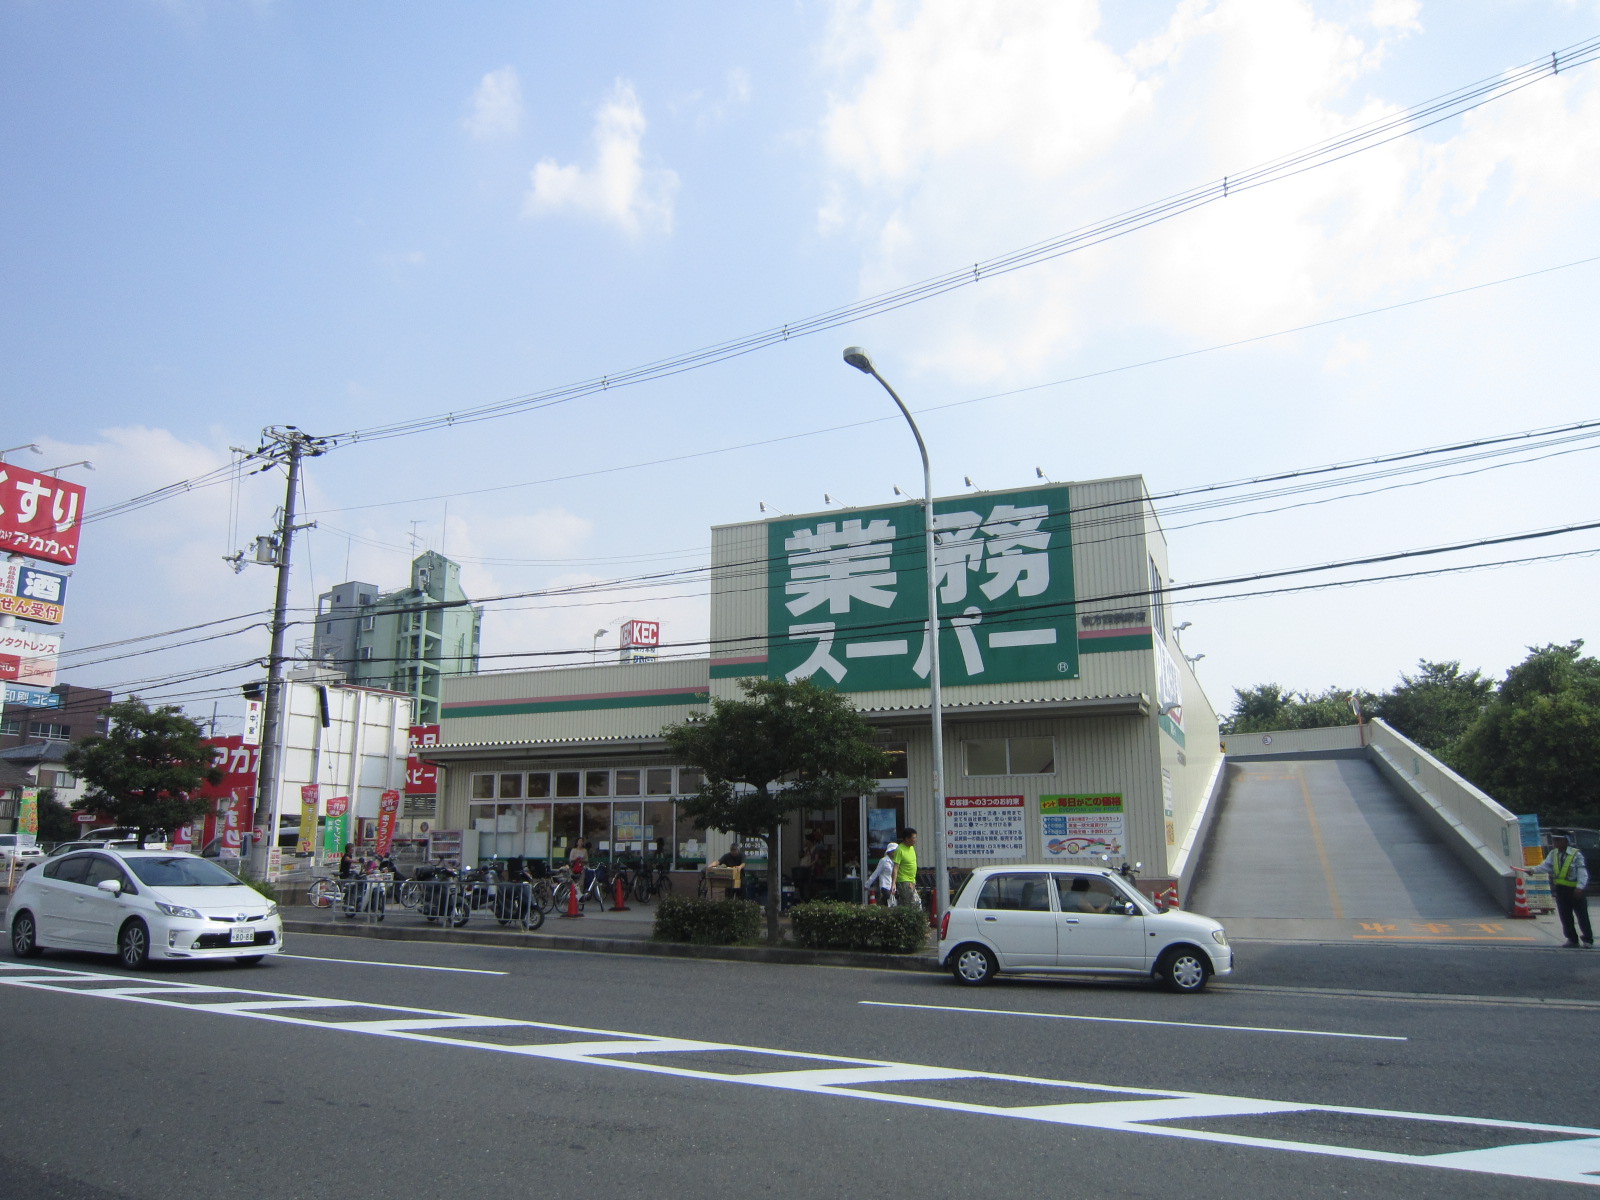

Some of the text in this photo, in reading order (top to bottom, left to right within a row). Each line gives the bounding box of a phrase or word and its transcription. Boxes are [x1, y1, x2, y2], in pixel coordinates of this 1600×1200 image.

[13, 531, 74, 559] アカカベ
[784, 505, 1052, 617] 業務
[24, 571, 61, 602] 酒
[633, 622, 657, 643] KEC
[785, 606, 1057, 685] スーパー
